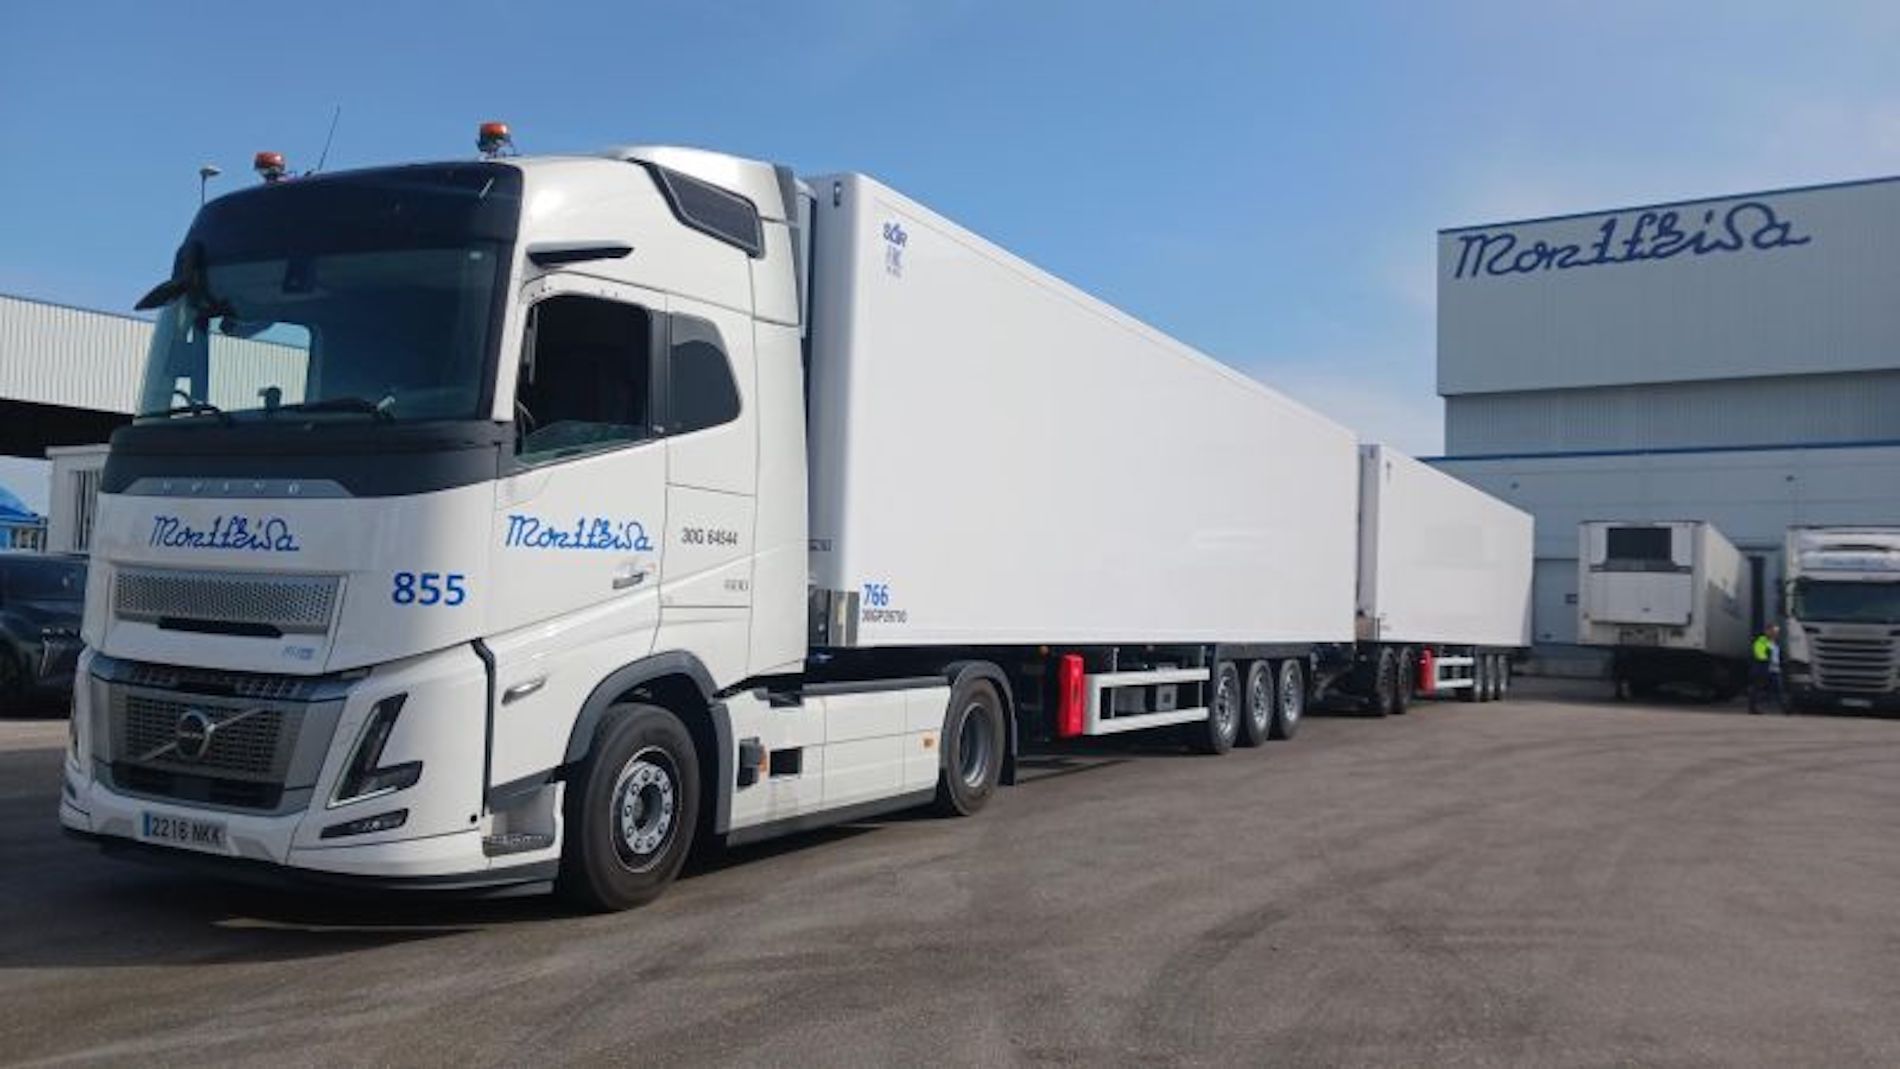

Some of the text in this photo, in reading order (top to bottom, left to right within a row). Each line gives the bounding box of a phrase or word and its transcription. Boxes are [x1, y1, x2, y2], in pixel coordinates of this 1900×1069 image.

[392, 572, 465, 606] 855
[864, 583, 889, 606] 766
[152, 816, 189, 841] 2216
